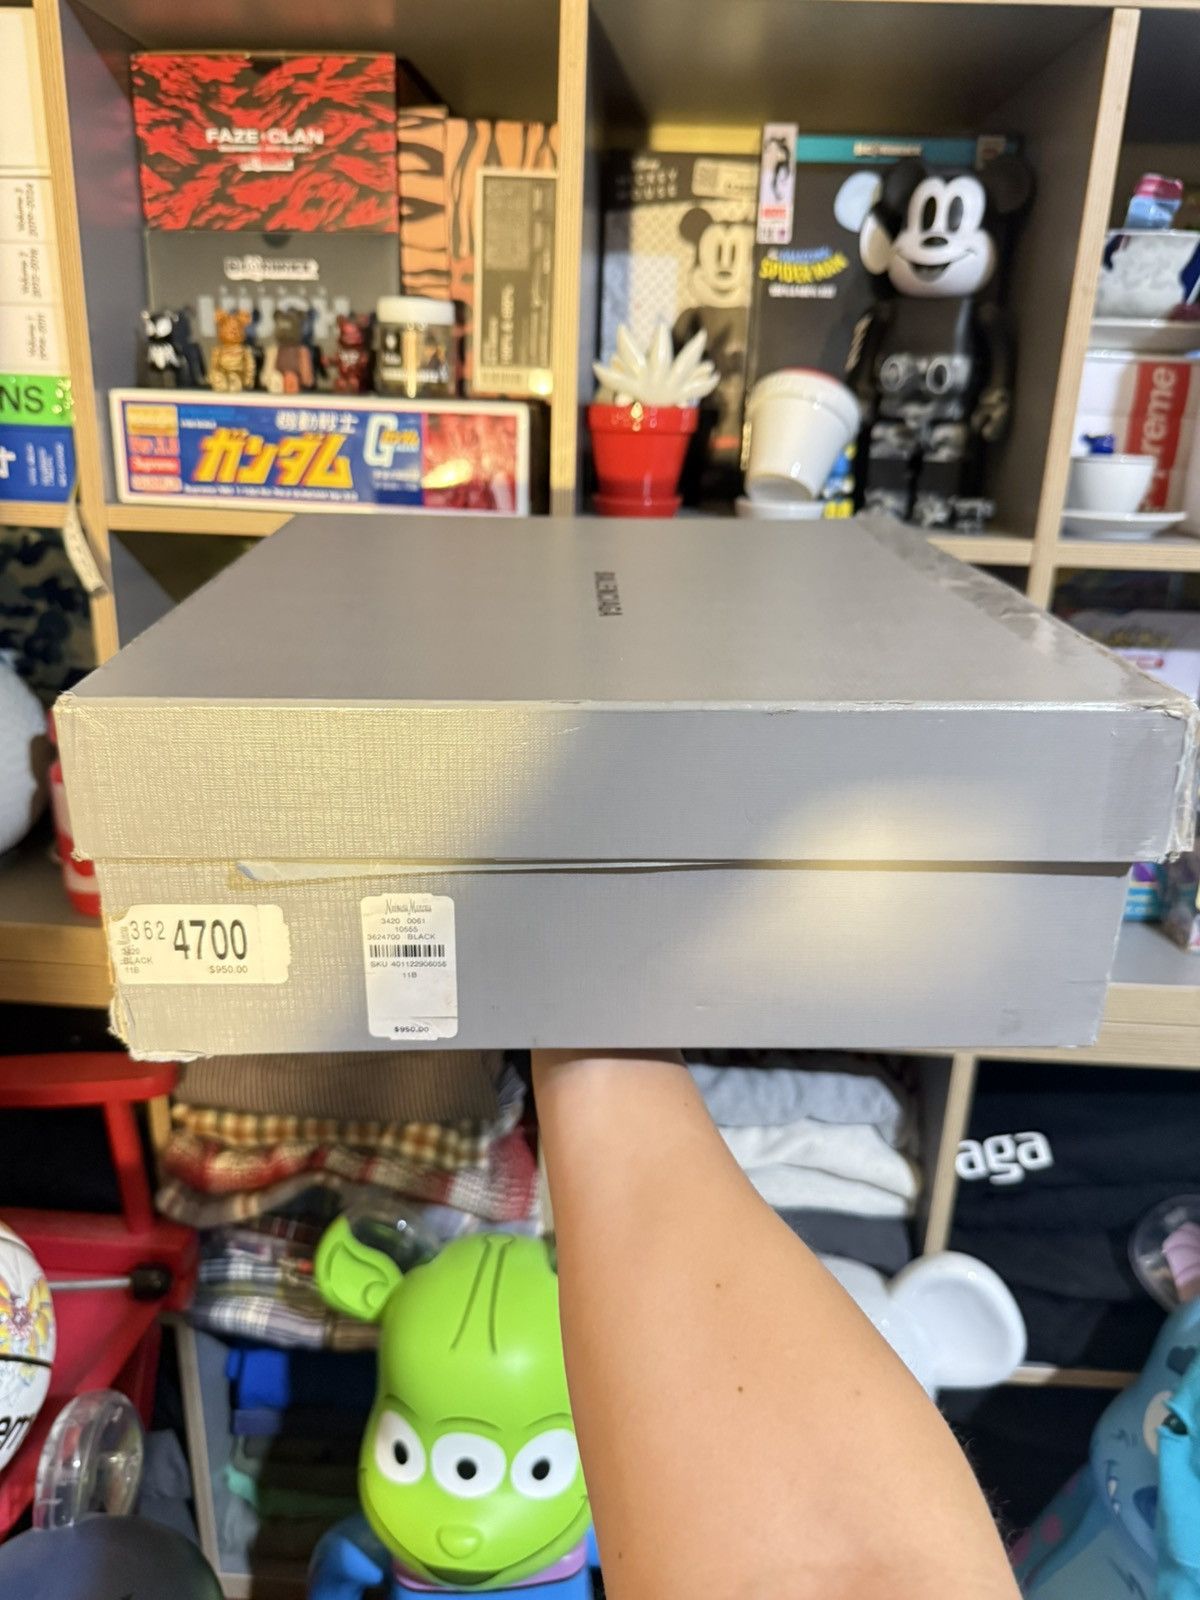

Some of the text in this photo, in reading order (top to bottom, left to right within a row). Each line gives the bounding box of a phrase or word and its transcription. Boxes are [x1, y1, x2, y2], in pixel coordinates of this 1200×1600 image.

[205, 128, 324, 145] FAZE CLAN
[193, 427, 354, 489] ガンダム
[130, 920, 166, 940] 362
[173, 919, 247, 960] 4700
[209, 965, 248, 974] $950.00
[955, 1131, 1054, 1185] aga
